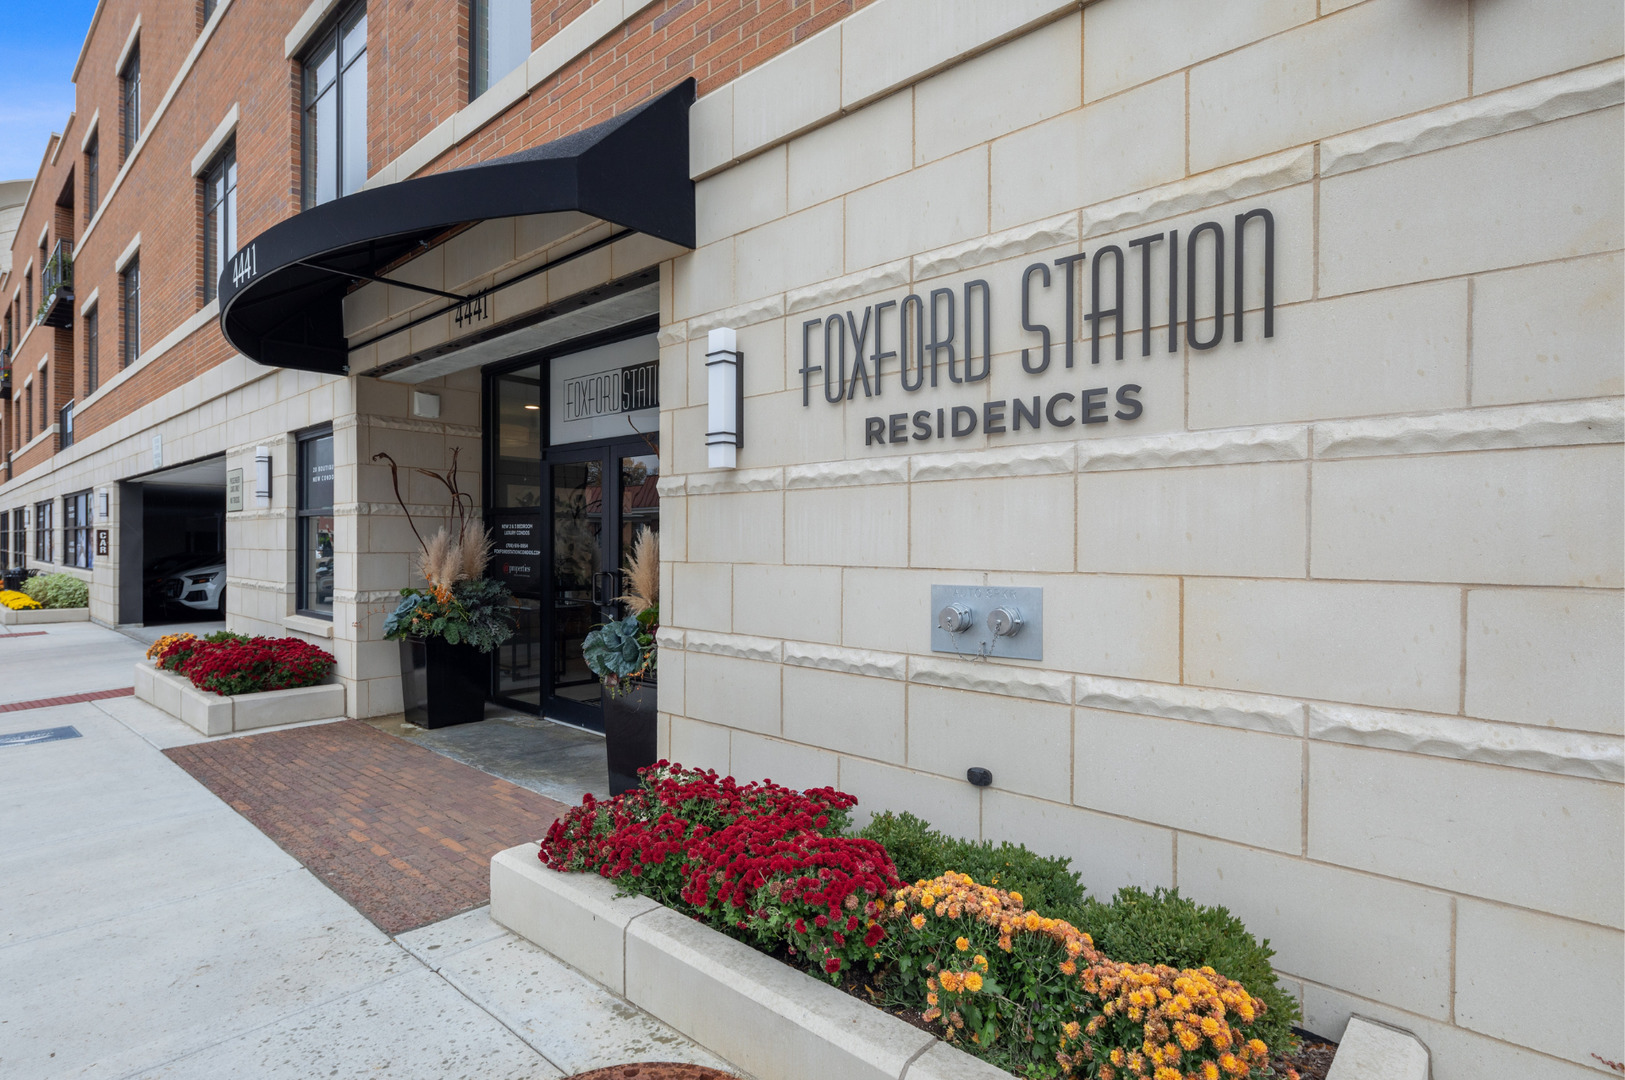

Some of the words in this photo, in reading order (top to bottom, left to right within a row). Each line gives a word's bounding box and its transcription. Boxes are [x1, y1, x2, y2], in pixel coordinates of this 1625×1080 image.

[232, 243, 258, 288] 4441
[455, 287, 488, 328] 4441
[799, 279, 991, 406] FOXFORD
[1022, 208, 1275, 375] STATION
[566, 373, 620, 418] FOXFORD
[622, 364, 658, 410] STATI
[865, 384, 1143, 446] RESIDENCES
